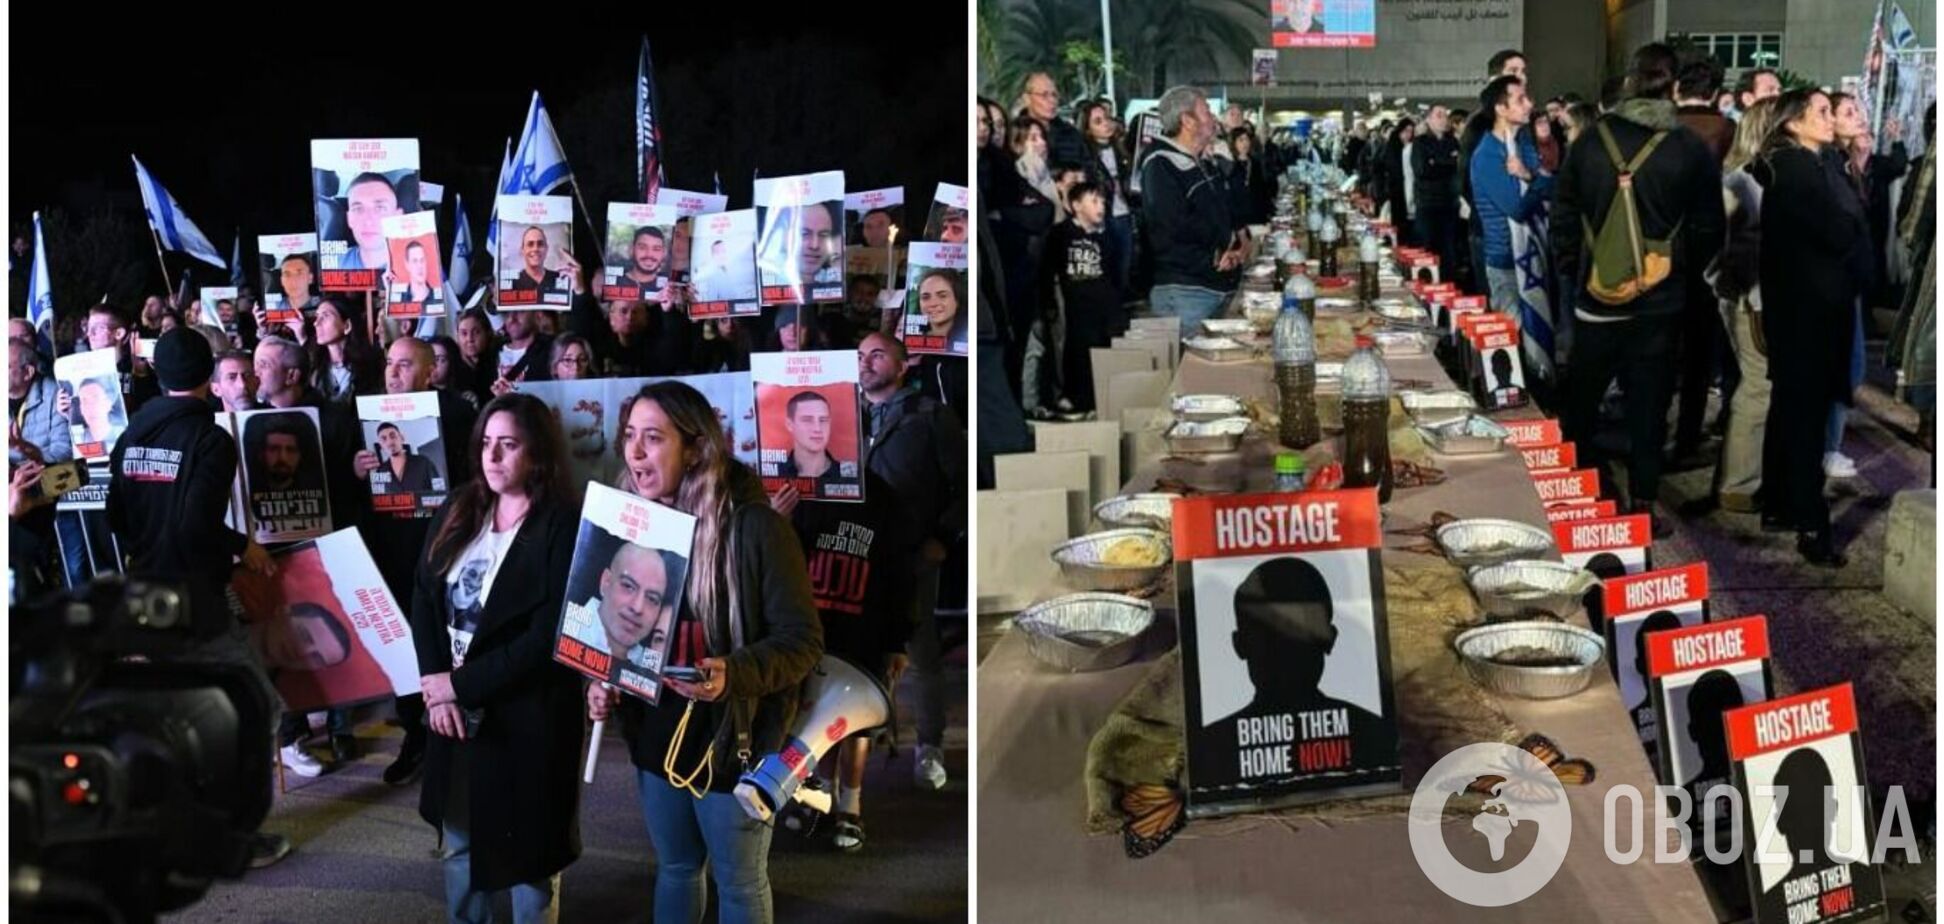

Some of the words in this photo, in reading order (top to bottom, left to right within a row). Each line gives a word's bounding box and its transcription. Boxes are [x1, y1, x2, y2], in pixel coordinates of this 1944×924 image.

[761, 449, 788, 463] BRING
[261, 499, 320, 517] הביתה
[1215, 502, 1341, 549] HOSTAGE
[1572, 521, 1632, 549] HOSTAGE
[1625, 573, 1688, 609] HOSTAGE
[567, 601, 593, 625] BRING
[559, 635, 584, 662] HOME
[584, 648, 612, 675] NOW!
[1672, 627, 1745, 668] HOSTAGE
[1237, 713, 1294, 746] BRING
[1298, 708, 1349, 738] THEM
[1754, 698, 1834, 747] HOSTAGE
[1239, 745, 1293, 778] HOME
[1298, 740, 1351, 771] NOW!
[1783, 872, 1819, 904] BRING
[1819, 864, 1852, 892] THEM
[1787, 897, 1821, 924] HOME
[1821, 885, 1854, 917] NOW!
